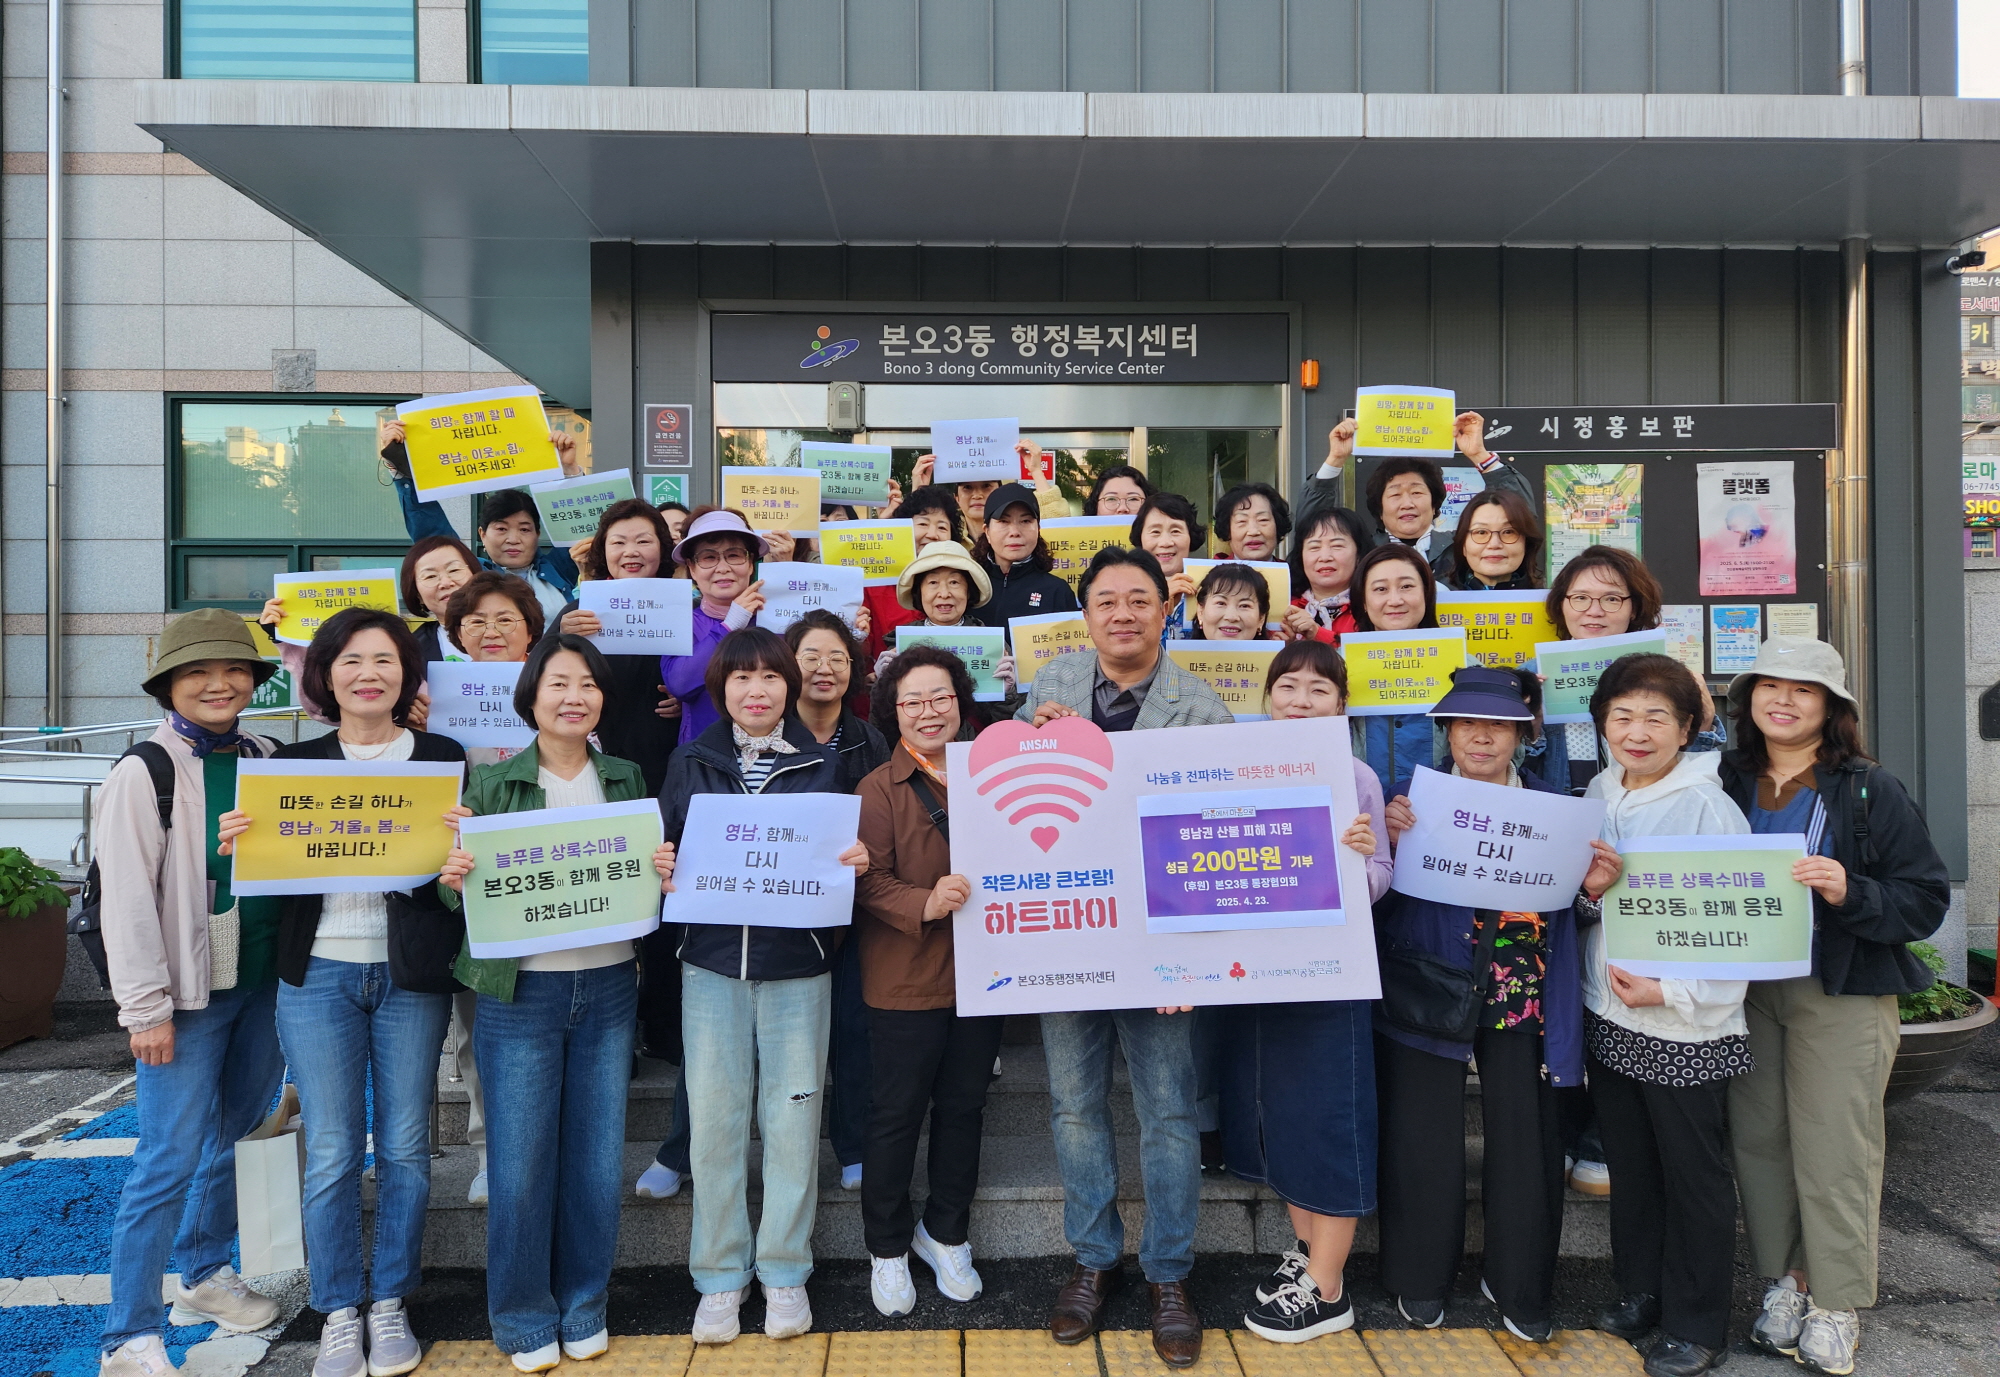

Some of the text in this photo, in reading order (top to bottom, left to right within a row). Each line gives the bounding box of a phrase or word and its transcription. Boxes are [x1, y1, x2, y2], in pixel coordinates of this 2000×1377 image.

[1971, 322, 1989, 343] 카
[878, 324, 1198, 358] 본오3동 행정복지센터
[884, 362, 1165, 378] Bono 3 dong Community Service Center
[429, 407, 516, 429] 희망은 함께 할 때
[1388, 411, 1422, 419] 자랍니다.
[451, 423, 502, 440] 자랍니다.
[955, 435, 975, 445] 영남,
[1383, 435, 1424, 444] 되어주세요!
[438, 442, 525, 466] 영남의 이웃에게 힘이
[968, 448, 985, 457] 다시
[454, 458, 516, 477] 되어주세요!
[947, 461, 968, 469] 일어설
[978, 459, 1008, 467] 있습니다.
[847, 472, 879, 482] 함께 응원
[742, 485, 760, 495] 따뜻한
[762, 486, 777, 495] 손길
[827, 485, 864, 495] 하겠습니다!
[1722, 478, 1770, 495] 플랫폼
[588, 506, 604, 517] 함께
[851, 542, 883, 550] 자랍니다.
[1050, 540, 1098, 551] 따뜻한 손길
[325, 588, 344, 597] 함께
[347, 587, 356, 596] 할
[360, 586, 369, 596] 때
[788, 580, 810, 591] 영남,
[609, 598, 664, 610] 영남, 함께라서
[802, 596, 821, 606] 다시
[626, 614, 646, 625] 다시
[1439, 613, 1533, 626] 희망은 함께 할 때
[597, 628, 676, 638] 일어설 수 있습니다.
[1032, 631, 1071, 644] 따뜻한 손길
[1367, 647, 1438, 659] 희망은 함께 할 때
[971, 659, 990, 670] 응원
[1189, 663, 1259, 672] 따뜻한 손길 하나가
[1382, 660, 1424, 669] 자랍니다.
[1560, 662, 1591, 673] 늘푸른
[461, 683, 488, 696] 영남,
[1240, 679, 1259, 688] 봄으로
[1368, 679, 1392, 689] 영남의
[1395, 678, 1424, 687] 이웃에게
[1379, 690, 1430, 699] 되어주세요!
[480, 701, 502, 713] 다시
[448, 717, 490, 728] 일어설 수
[1019, 739, 1057, 752] ANSAN
[1146, 762, 1316, 786] 나눔을 전파하는 따뜻한 에너지
[279, 794, 413, 810] 따뜻한 손길 하나가
[278, 819, 411, 836] 영남의 겨울을 봄으로
[1179, 822, 1293, 841] 영남권 산불 피해 지원
[1453, 809, 1548, 842] 영남, 함께라서
[725, 823, 809, 843] 영남, 함께라서
[306, 842, 387, 858] 바꿉니다.!
[495, 835, 628, 869] 늘푸른 상록수마을
[1476, 841, 1514, 862] 다시
[745, 851, 779, 869] 다시
[1165, 845, 1314, 875] 성금 200만원 기부
[1422, 855, 1557, 886] 일어설 수 있습니다.
[483, 858, 642, 899] 본오3동이 함께 응원
[982, 868, 1114, 893] 작은사랑 큰보람!
[1184, 876, 1298, 892] (후원) 본오3동 통장협의회
[1627, 871, 1766, 889] 늘푸른 상록수마을
[695, 875, 825, 896] 일어설 수 있습니다.
[1216, 896, 1270, 907] 2025. 4. 23.
[1618, 897, 1783, 917] 본오3동이 함께 응원
[523, 896, 610, 923] 하겠습니다!
[983, 896, 1119, 935] 하트파이
[1656, 930, 1749, 947] 하겠습니다!
[1018, 970, 1115, 987] 본오3동행정복지센터
